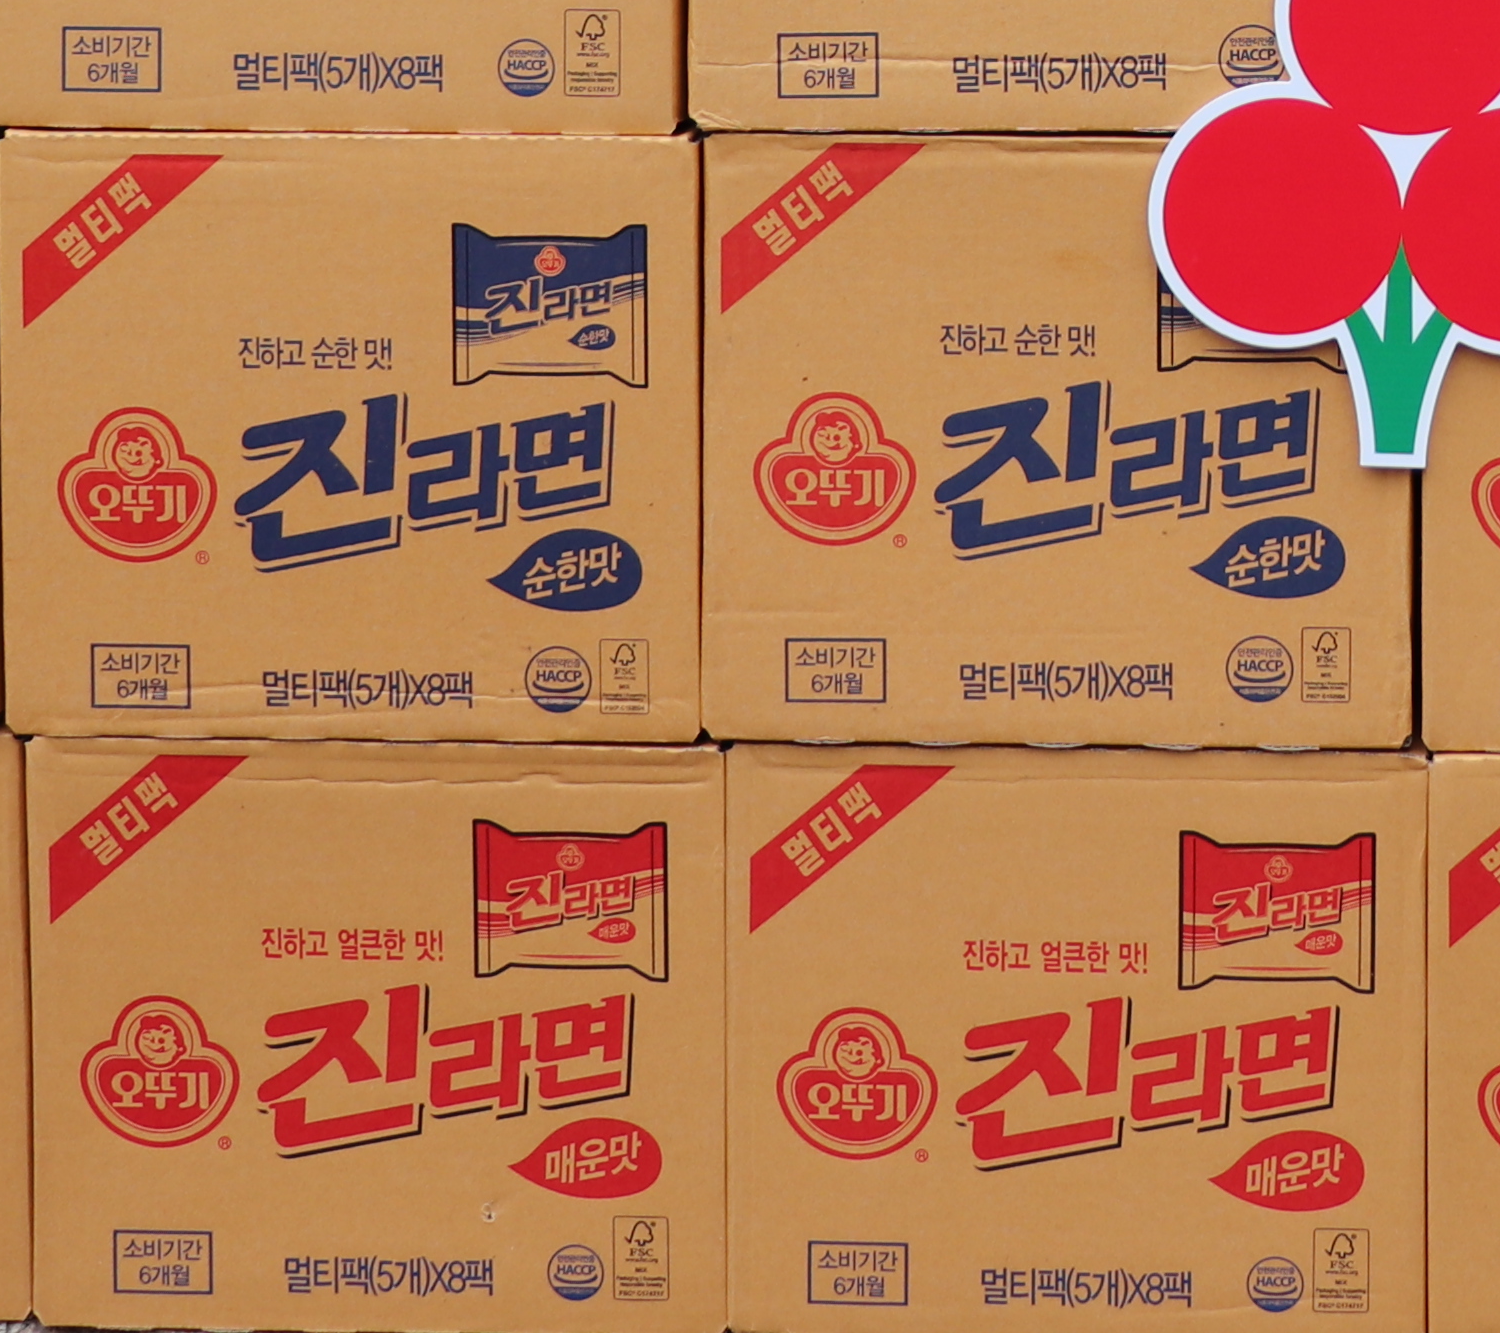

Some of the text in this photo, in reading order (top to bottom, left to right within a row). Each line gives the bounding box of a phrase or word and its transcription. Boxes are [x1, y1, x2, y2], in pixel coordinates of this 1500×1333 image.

[233, 52, 444, 94] 멀티팩(5개)X8팩
[752, 160, 854, 257] 멀티팩
[485, 277, 613, 336] 진라면
[234, 392, 616, 573] 진라면
[934, 379, 1321, 561] 진라면
[522, 543, 621, 599] 순한맛
[1225, 529, 1325, 588] 순한맛
[506, 872, 635, 933] 진라면
[256, 984, 635, 1164] 진라면
[956, 996, 1339, 1176] 진라면
[545, 1130, 642, 1186] 매운맛
[1246, 1143, 1344, 1198] 매운맛
[817, 1251, 898, 1272] 소비기간
[834, 1276, 886, 1297] 6개월
